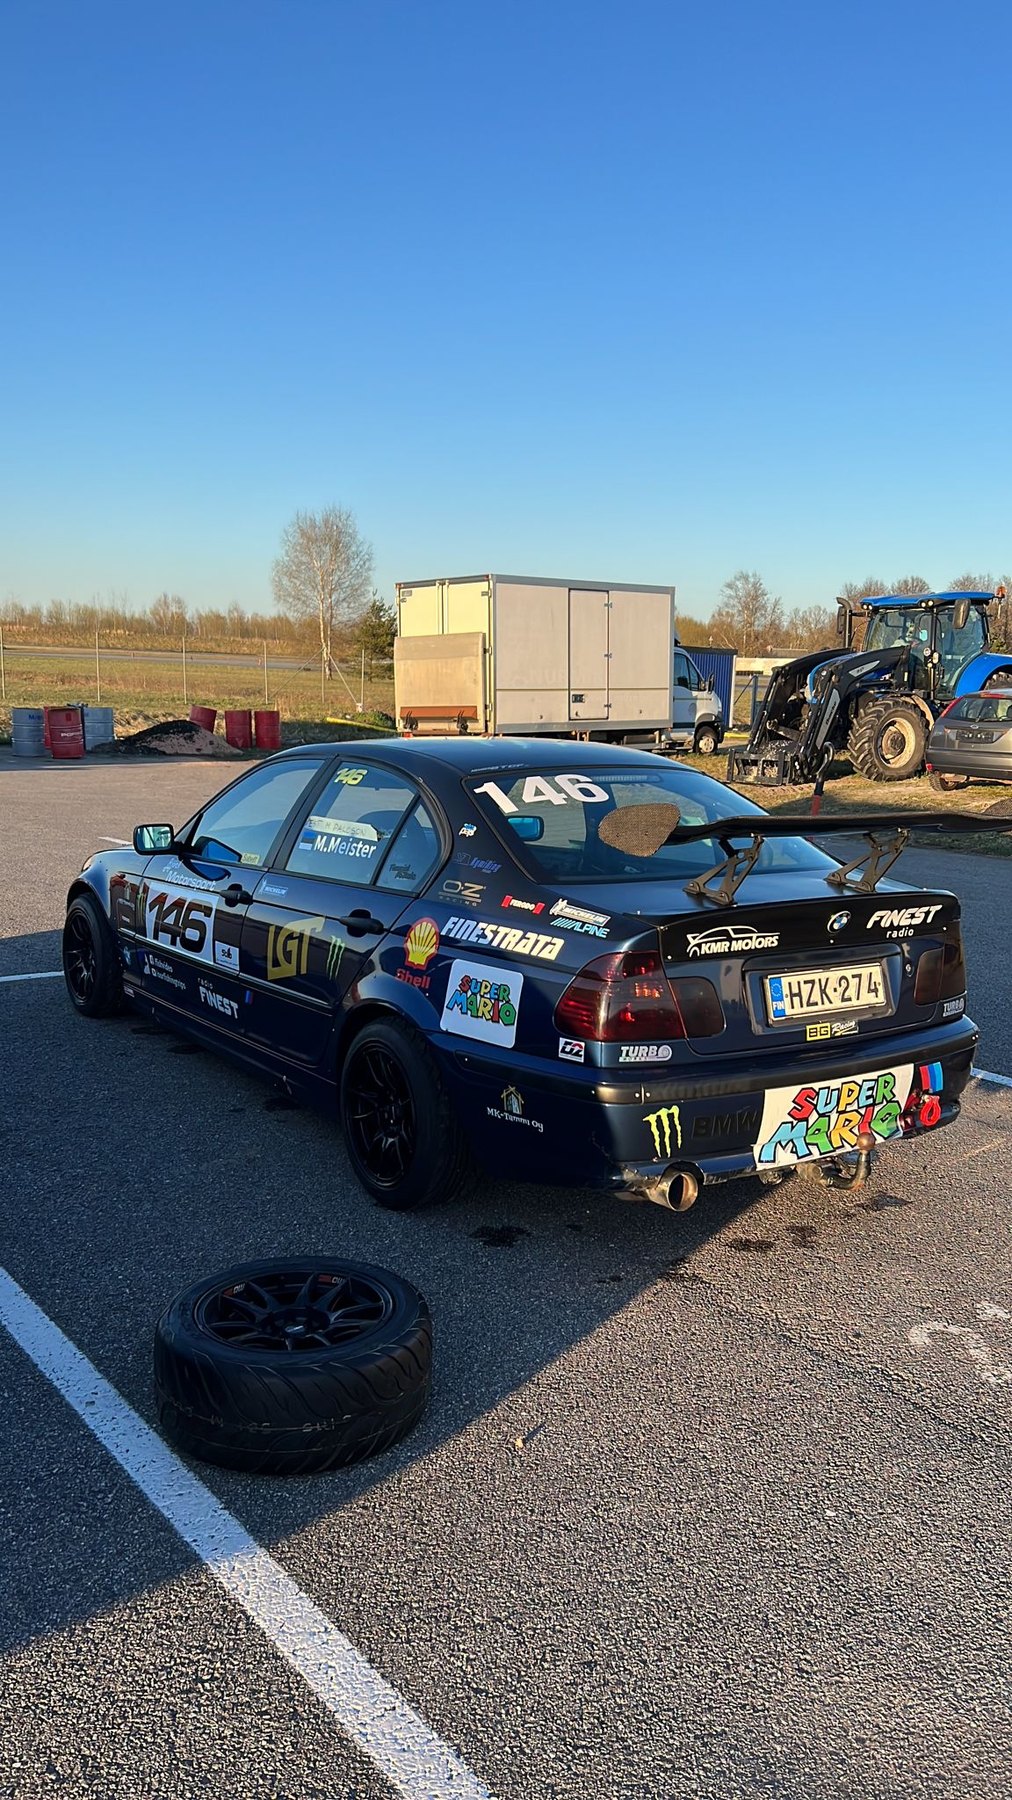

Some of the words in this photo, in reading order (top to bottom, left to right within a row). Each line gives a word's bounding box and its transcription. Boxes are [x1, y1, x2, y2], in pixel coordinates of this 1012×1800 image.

[334, 768, 368, 786] 146
[474, 774, 610, 814] 146
[313, 835, 377, 859] M.Meister
[164, 870, 217, 891] Motorsport
[510, 899, 536, 911] FERODO
[563, 906, 607, 923] MICHELIN
[866, 904, 943, 929] FINEST
[148, 892, 213, 953] 146
[569, 921, 610, 938] ALPINE
[886, 927, 915, 938] radio
[440, 916, 565, 961] FINESTRATA
[701, 941, 729, 954] KMR
[730, 934, 779, 951] MOTORS
[395, 968, 431, 989] Shell
[458, 975, 511, 1002] SUPER
[788, 971, 879, 1010] HZK-274
[199, 986, 239, 1018] FINEST
[446, 989, 517, 1026] MARIO
[773, 1000, 785, 1011] FIN
[832, 1020, 856, 1035] Racing
[788, 1072, 896, 1121] SUPER
[531, 1119, 544, 1133] Oy
[691, 1110, 758, 1140] BMW
[758, 1101, 902, 1163] MARIO
